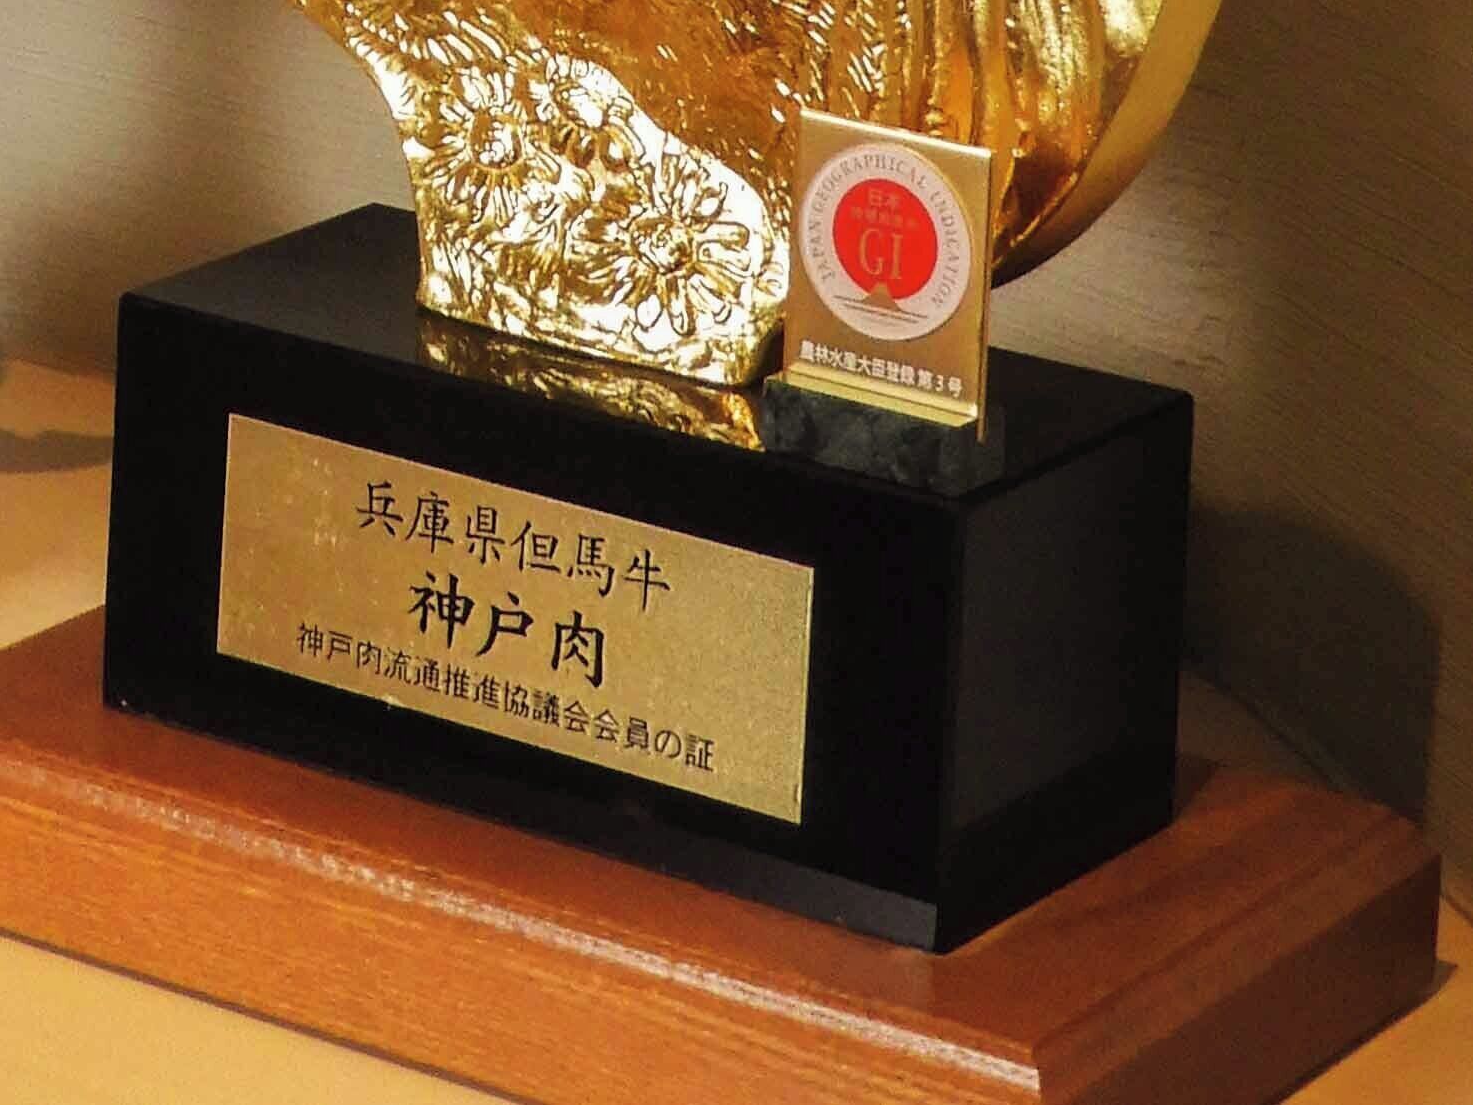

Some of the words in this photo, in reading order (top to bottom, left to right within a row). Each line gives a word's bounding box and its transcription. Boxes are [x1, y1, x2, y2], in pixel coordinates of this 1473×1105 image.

[808, 220, 836, 282] JAPAN
[859, 228, 904, 280] GI
[800, 340, 915, 385] 農林水産大臣登録
[356, 481, 672, 612] 兵庫県但馬牛
[409, 570, 606, 689] 神戸肉
[297, 622, 715, 772] 神戸肉流通推進協議会会員の証
